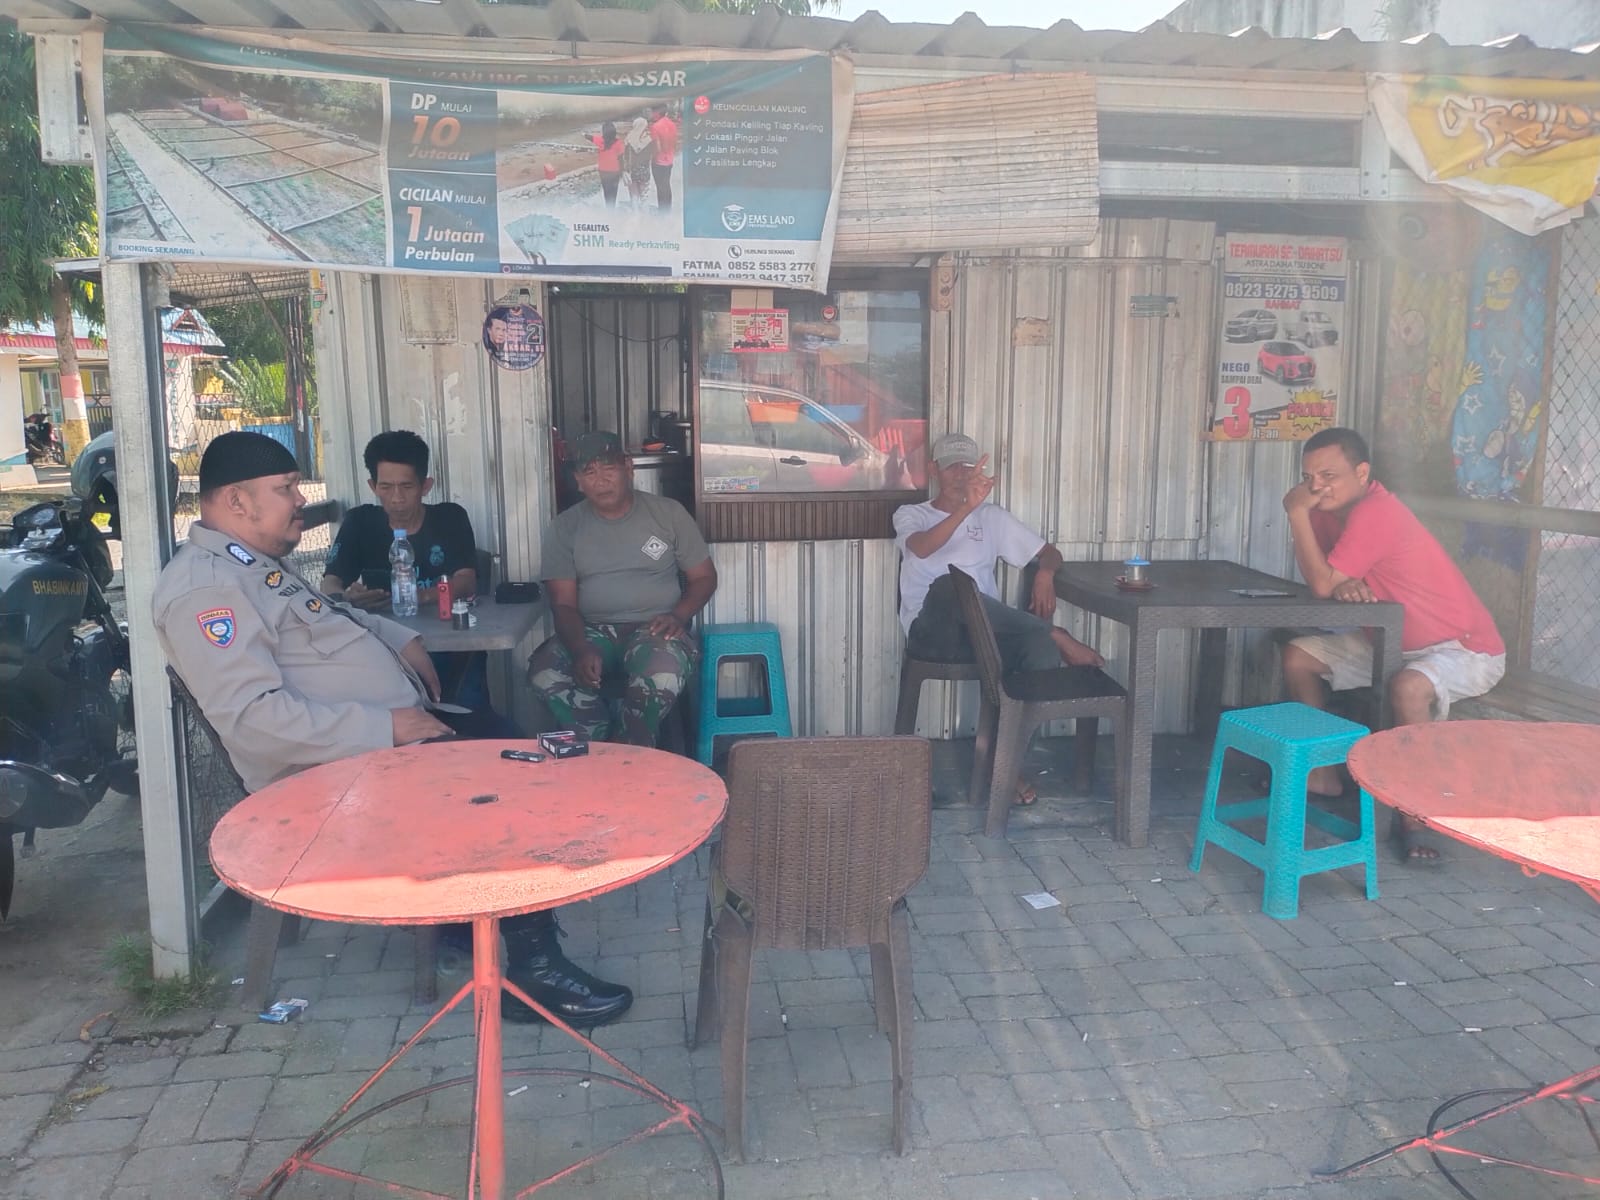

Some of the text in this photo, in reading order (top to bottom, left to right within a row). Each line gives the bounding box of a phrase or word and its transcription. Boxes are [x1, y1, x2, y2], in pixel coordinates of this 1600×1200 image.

[567, 70, 686, 87] MAKASSAR
[411, 93, 472, 112] DP MULAI
[713, 103, 769, 112] KEUNGGULAN
[771, 105, 806, 114] KAVLING
[411, 115, 462, 146] 10
[705, 120, 739, 129] Pondasi
[793, 122, 824, 133] Kavling
[705, 133, 788, 143] Lokasi Pinggir Jalan
[408, 145, 471, 160] Jutaan
[705, 145, 778, 155] Jalan Paving Blok
[705, 158, 777, 168] Fasilitas Lengkap
[400, 187, 486, 204] CICILAN MULAI
[407, 206, 485, 243] 1 Jutaan
[573, 223, 610, 232] LEGALITAS
[749, 214, 796, 226] EMS LAND
[573, 233, 681, 251] SHM Ready Perkavling
[405, 246, 474, 263] Perbulan
[682, 261, 722, 270] FATMA
[728, 261, 755, 271] 0852
[758, 262, 786, 271] 5583
[1226, 282, 1339, 300] 0823 5275 9509
[1221, 362, 1250, 373] NEGO
[1223, 386, 1252, 439] 3
